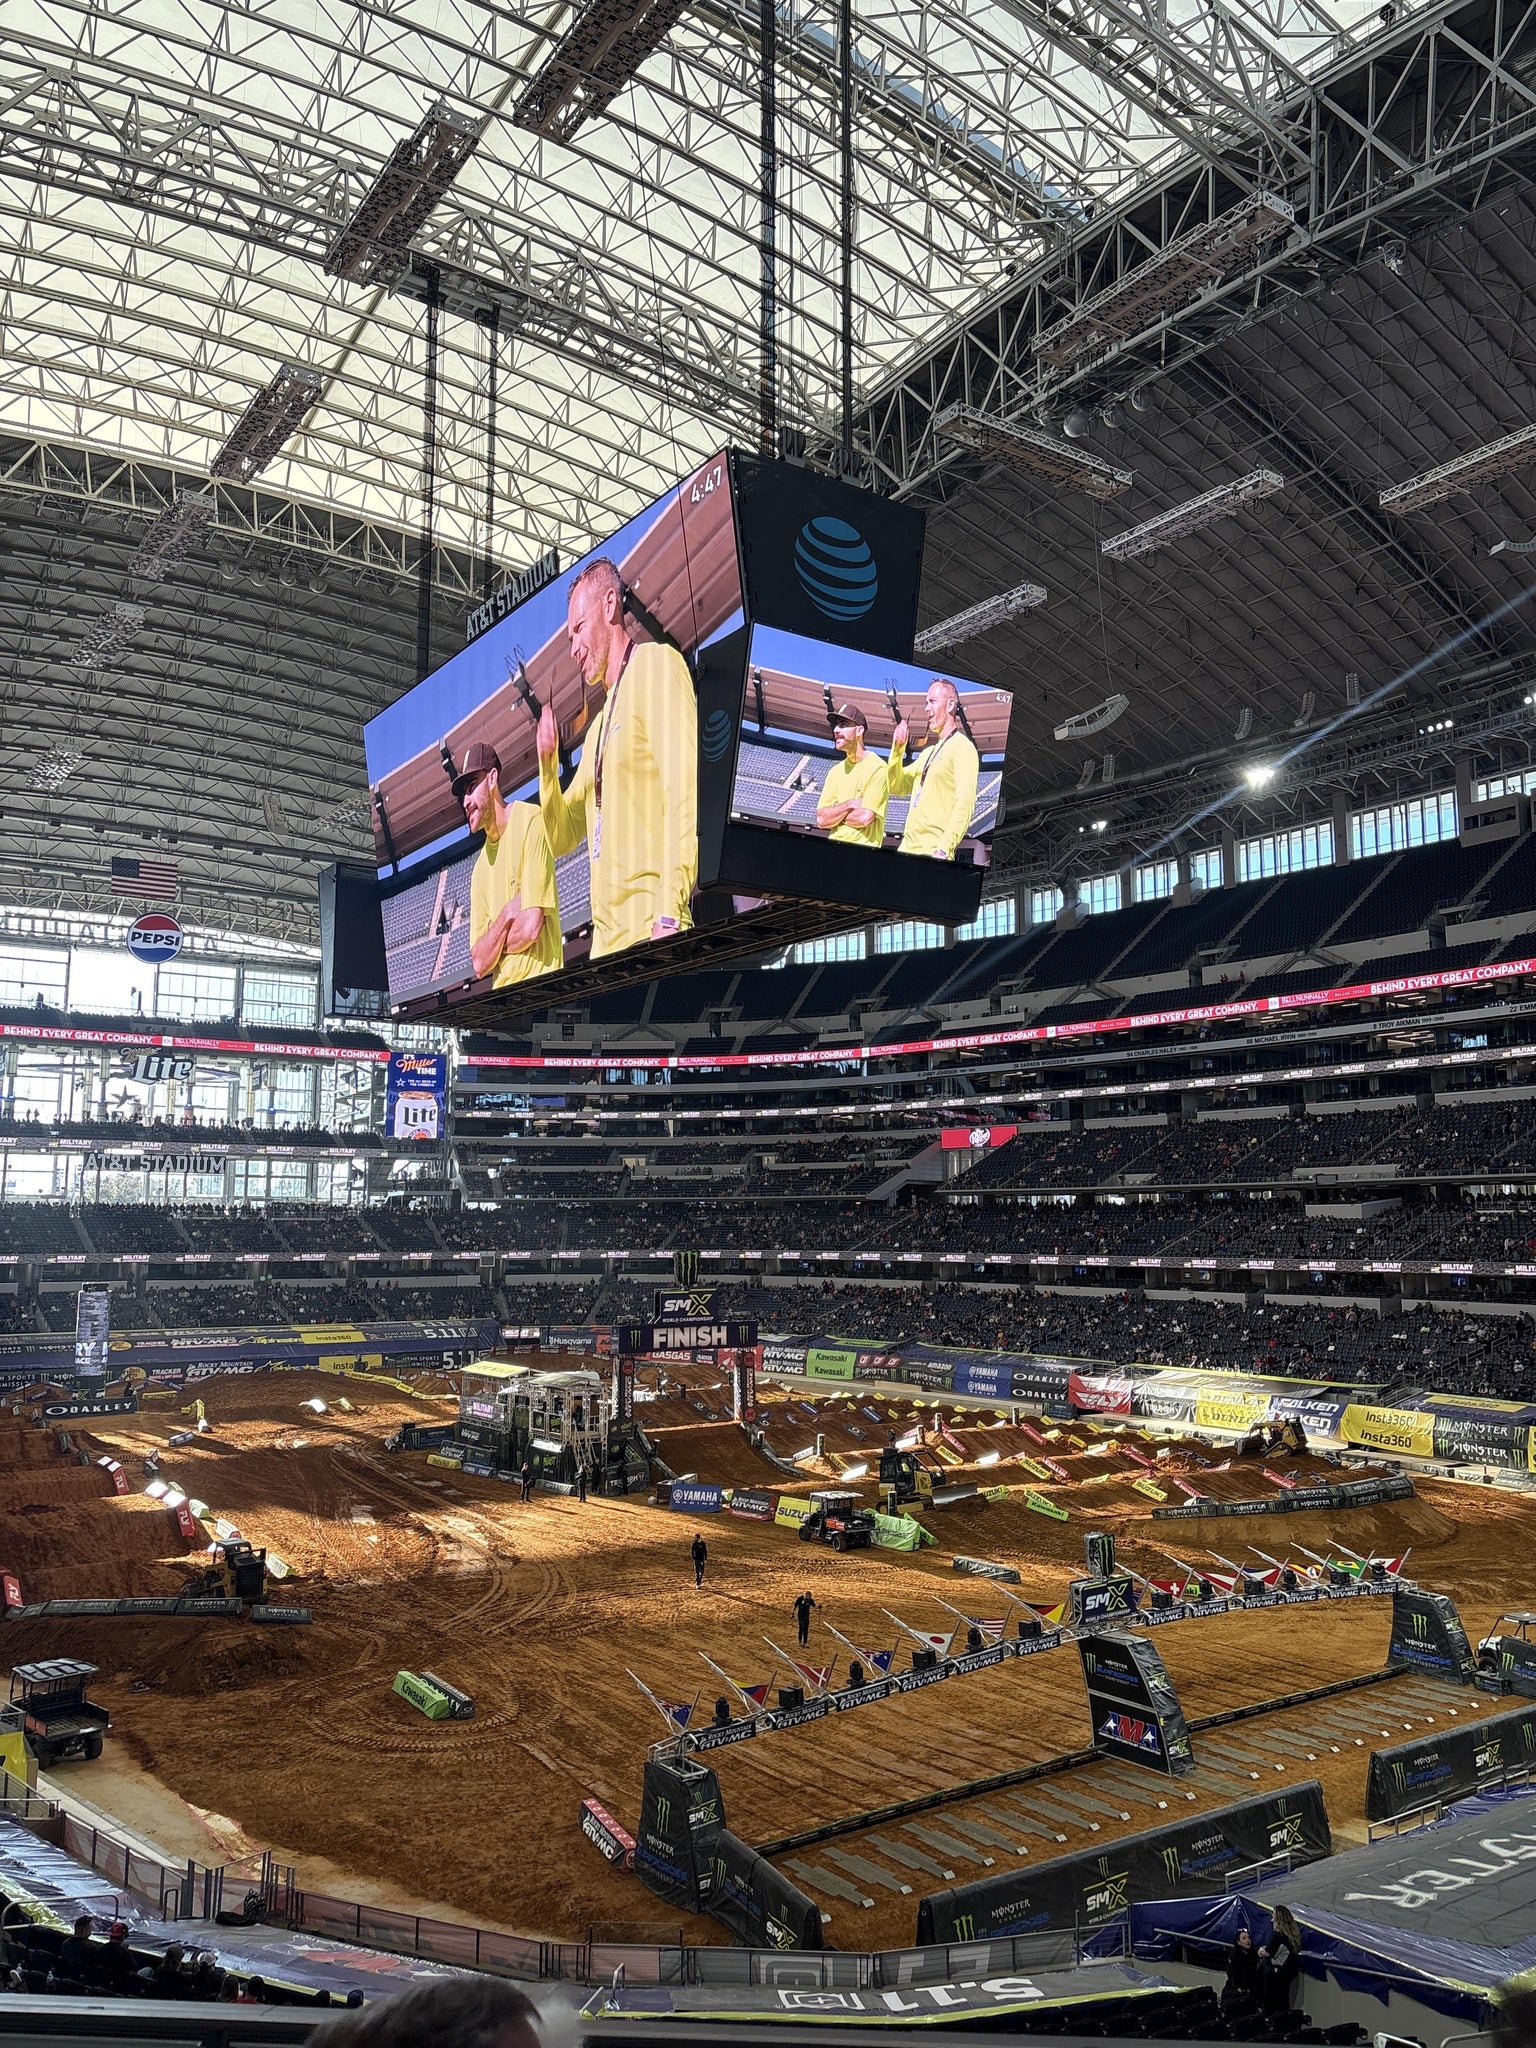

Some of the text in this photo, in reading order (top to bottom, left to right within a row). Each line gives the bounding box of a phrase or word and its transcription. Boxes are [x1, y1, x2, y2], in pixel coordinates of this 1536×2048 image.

[691, 465, 722, 503] 4:47
[467, 549, 557, 642] AT&T STADIUM
[131, 931, 181, 947] PEPSI
[1370, 962, 1532, 994] BEHIND EVERY GREAT COMPANY.
[1130, 1001, 1258, 1026] BEHIND EVERY GREAT COMPANY.
[1378, 1021, 1395, 1029] TROY
[1395, 1018, 1421, 1027] AIKMAN
[4, 1026, 153, 1044] BEHIND EVERY GREAT COMPANY.
[932, 1030, 1038, 1049] BEHIND EVERY GREAT COMPANY.
[1254, 1035, 1280, 1043] MICHAEL
[254, 1044, 285, 1054] BEHIND
[286, 1046, 313, 1056] EVERY
[314, 1048, 340, 1057] GREAT
[341, 1050, 381, 1060] COMPANY.
[748, 1049, 854, 1064] BEHIND EVERY GREAT COMPANY.
[1133, 1049, 1158, 1057] CHARLES
[132, 1054, 194, 1085] Lite
[396, 1058, 438, 1073] Miller
[544, 1058, 660, 1066] BEHIND EVERY GREAT COMPANY.
[417, 1067, 437, 1075] TIME
[403, 1106, 436, 1127] Lite
[84, 1153, 226, 1174] AT&T STADIUM
[1441, 1264, 1473, 1272] MILITARY
[662, 1293, 713, 1316] SMX
[423, 1329, 461, 1338] 5.11
[553, 1336, 592, 1346] Husqvarna
[653, 1325, 727, 1349] FINISH
[652, 1351, 691, 1361] GASGAS
[815, 1352, 847, 1362] Kawasaki
[814, 1365, 846, 1376] Kawasaki
[861, 1368, 888, 1376] MONSTER
[927, 1362, 952, 1371] amazon
[976, 1367, 998, 1377] YAMAHA
[910, 1371, 943, 1384] MONSTER
[1028, 1374, 1068, 1384] OAKLEY
[974, 1383, 997, 1393] YAMAHA
[1027, 1390, 1066, 1400] OAKLEY
[70, 1402, 133, 1413] OAKLEY
[473, 1402, 494, 1413] MILITARY
[1280, 1398, 1340, 1413] FALKEN
[1365, 1411, 1415, 1427] Insta360
[1454, 1420, 1508, 1436] MONSTER
[1360, 1429, 1412, 1448] Insta360
[1453, 1441, 1508, 1459] MONSTER
[1462, 1455, 1500, 1464] ENERGY
[1023, 1458, 1049, 1478] SUZUKI
[683, 1489, 718, 1502] YAMAHA
[1135, 1480, 1166, 1500] SUZUKI
[1295, 1488, 1329, 1496] MONSTER
[1167, 1505, 1200, 1516] MONSTER
[1233, 1503, 1267, 1513] MONSTER
[1300, 1498, 1331, 1508] MONSTER
[1085, 1583, 1129, 1611] SMX
[1085, 1608, 1131, 1623] WORLD CHAMPIONSHIP
[1039, 1636, 1058, 1645] MOUNTAIN
[1405, 1638, 1438, 1651] MONSTER
[966, 1650, 1001, 1669] ROCKY MOUNTAIN
[1392, 1646, 1453, 1666] SUPERCROSS
[1403, 1656, 1440, 1669] CHAMPIONSHIP
[1105, 1659, 1128, 1670] MONSTER
[908, 1666, 946, 1682] ROCKY MOUNTAIN
[1097, 1664, 1139, 1683] SUPERCROSS
[401, 1679, 428, 1708] Kawasaki
[846, 1684, 886, 1700] ROCKY MOUNTAIN
[783, 1703, 826, 1719] ROCKY MOUNTAIN
[708, 1724, 753, 1740] ROCKY MOUNTAIN
[1098, 1711, 1161, 1751] AMA
[1169, 1739, 1190, 1755] SMX
[1414, 1753, 1440, 1766] MONSTER
[1475, 1744, 1503, 1767] SMX
[1406, 1764, 1453, 1785] SUPERCROSS
[688, 1802, 719, 1824] SMX
[1270, 1818, 1304, 1848] SMX
[646, 1833, 675, 1856] MONSTER
[1191, 1833, 1224, 1851] MONSTER
[1181, 1846, 1242, 1873] SUPERCROSS
[1086, 1879, 1130, 1912] SMX
[991, 1898, 1031, 1918] MONSTER
[998, 1910, 1027, 1924] ENERGY
